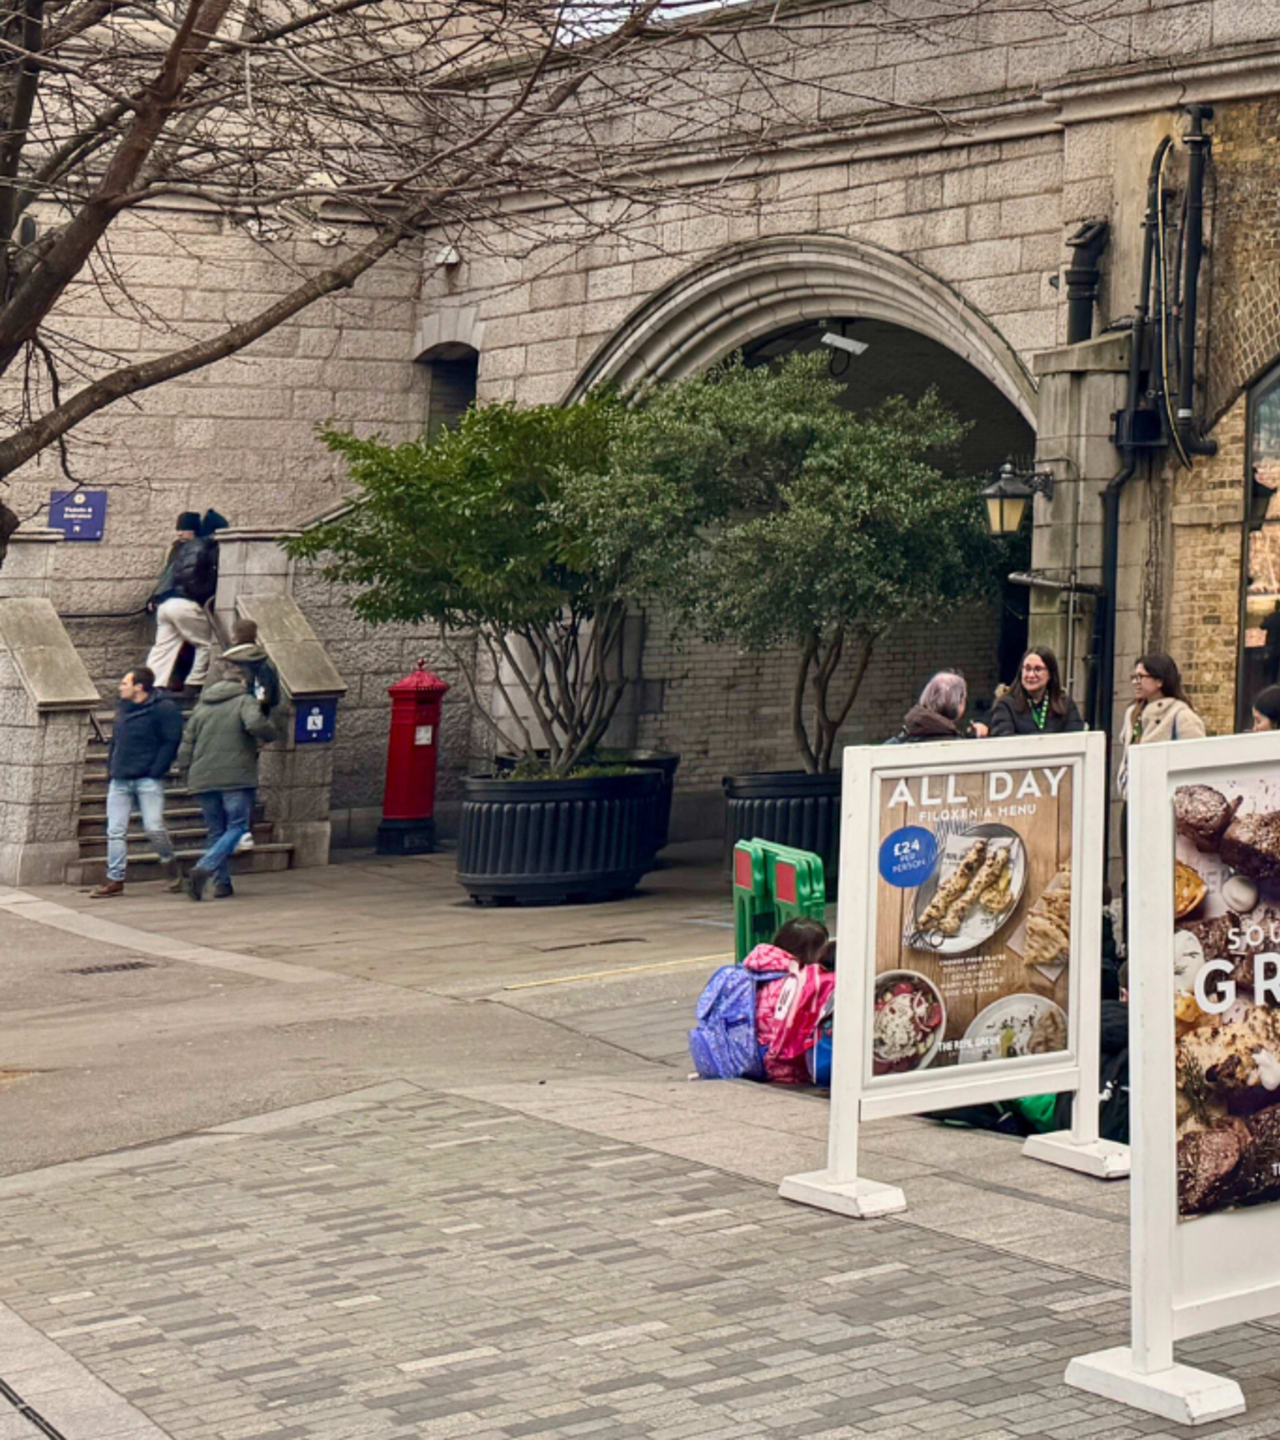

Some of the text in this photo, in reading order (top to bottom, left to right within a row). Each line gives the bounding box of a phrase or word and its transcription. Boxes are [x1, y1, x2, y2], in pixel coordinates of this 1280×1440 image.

[888, 766, 1068, 809] ALL DAY
[999, 803, 1037, 818] MENU
[893, 838, 920, 857] £24
